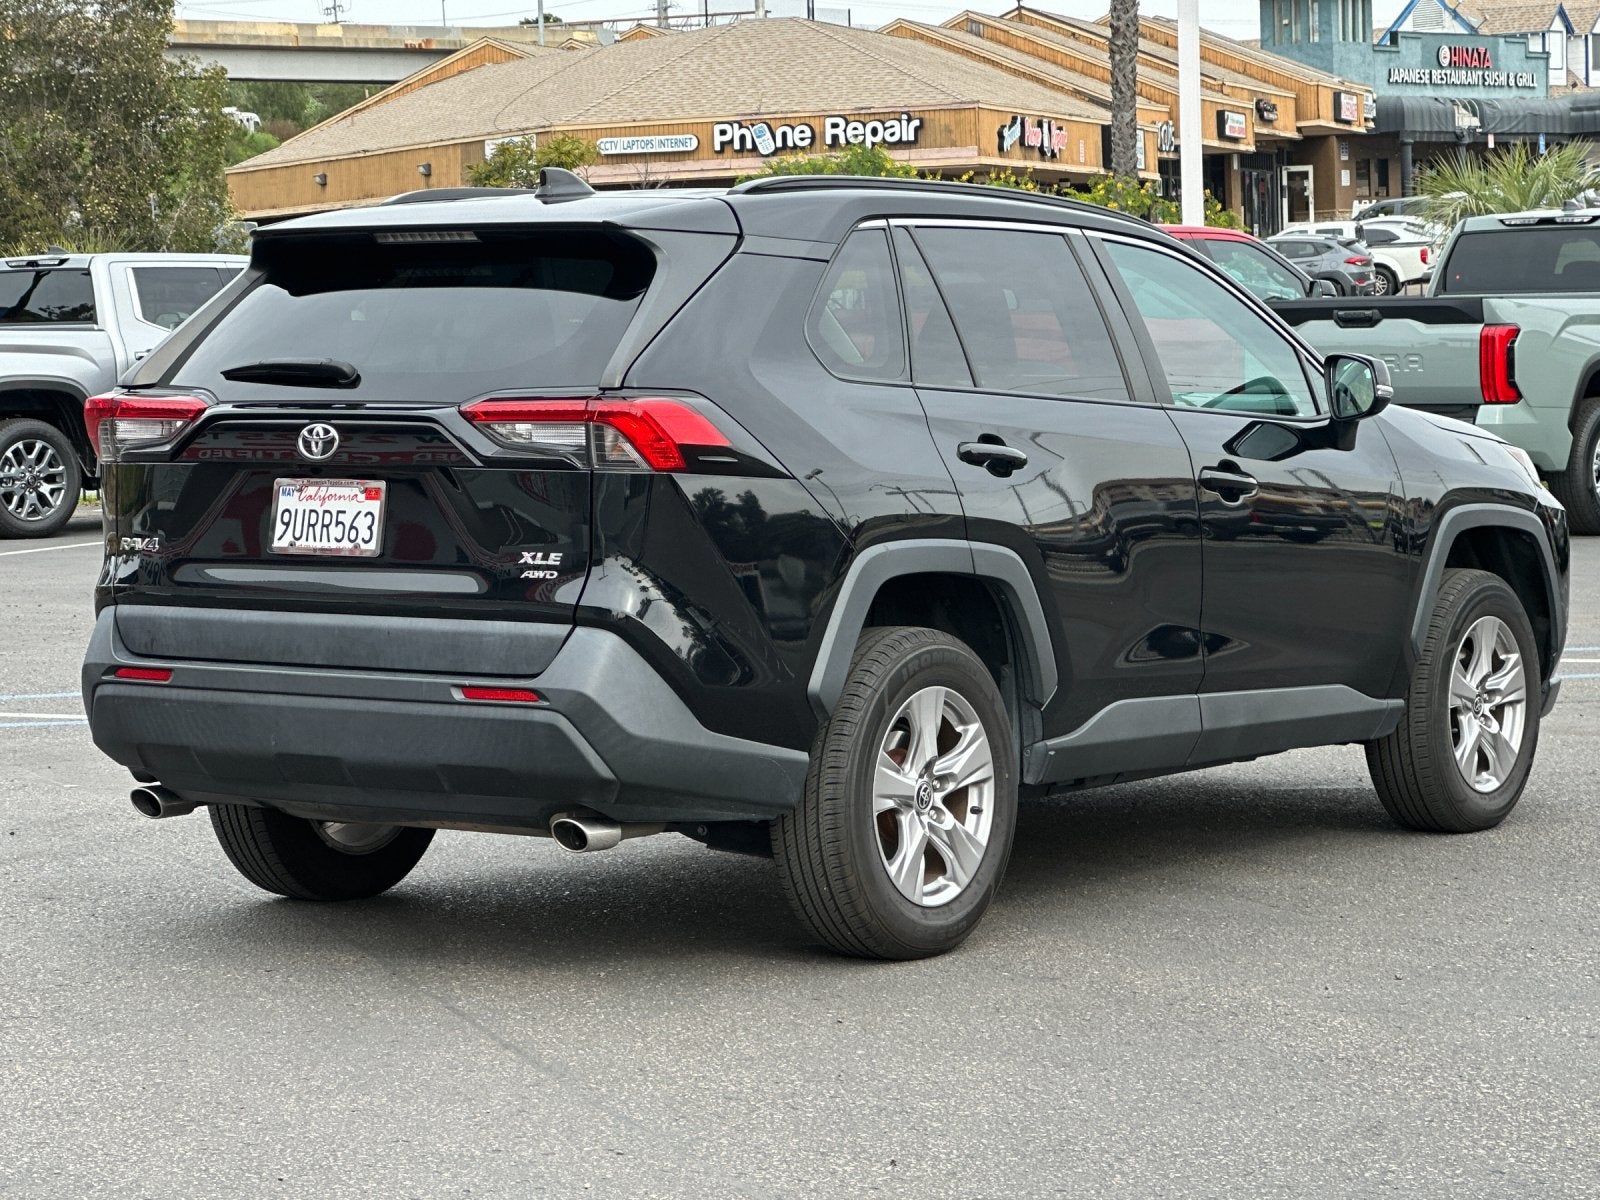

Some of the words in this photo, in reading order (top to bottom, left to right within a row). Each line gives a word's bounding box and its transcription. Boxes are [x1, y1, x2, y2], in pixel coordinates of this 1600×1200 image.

[1449, 46, 1492, 68] HINATA
[1389, 68, 1430, 84] JAPANESE
[1431, 69, 1483, 86] RESTAURANT
[1484, 71, 1507, 86] SUSHI
[1508, 72, 1515, 86] &
[1516, 73, 1538, 88] GRILL
[825, 113, 921, 149] Repair
[599, 140, 619, 151] CCTV
[622, 138, 655, 150] LAPTOPS
[657, 136, 693, 149] INTERNET
[281, 487, 295, 497] MAY
[298, 485, 365, 507] California
[277, 508, 376, 544] 9URR563
[119, 537, 160, 553] RAV4
[518, 551, 563, 566] XLE
[519, 570, 559, 580] AWD
